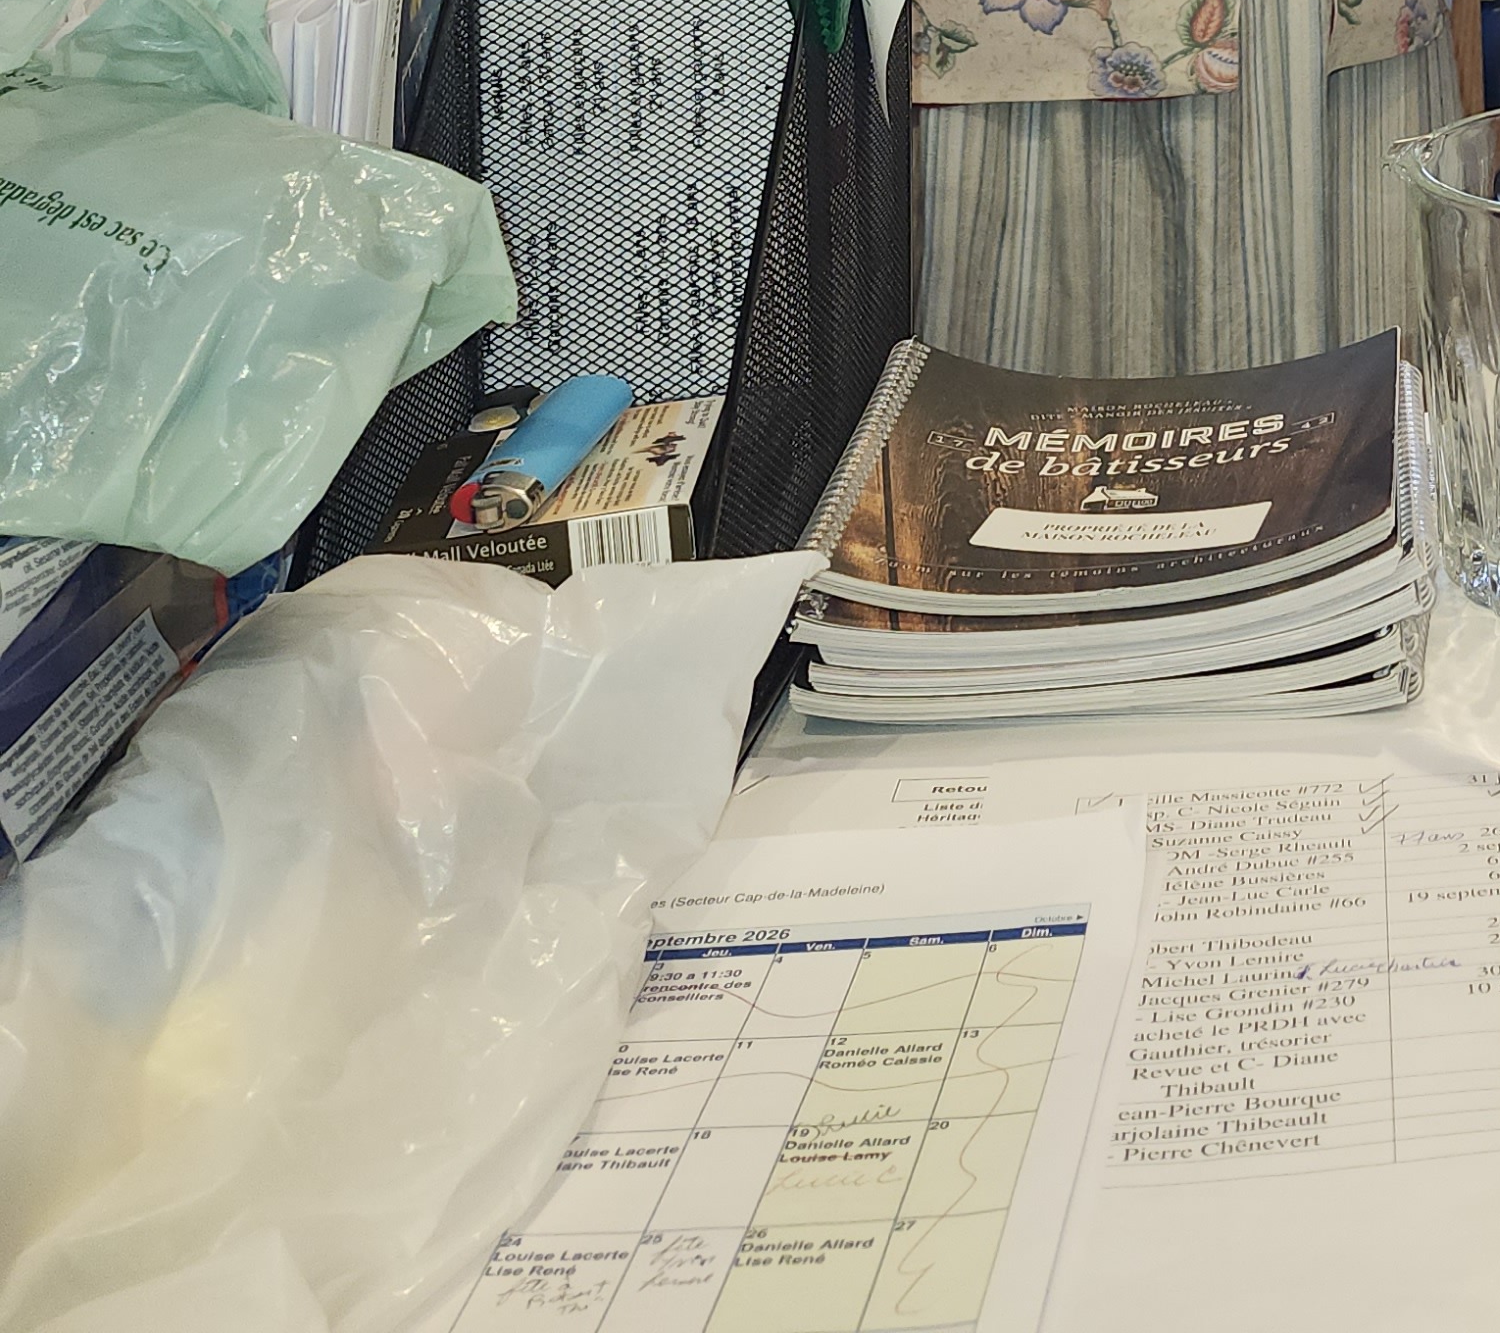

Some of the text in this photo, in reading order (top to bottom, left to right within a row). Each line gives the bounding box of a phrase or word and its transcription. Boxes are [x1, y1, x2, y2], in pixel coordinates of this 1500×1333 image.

[70, 207, 107, 234] est
[104, 218, 144, 251] sac
[140, 239, 174, 274] Ce
[984, 413, 1285, 453] MÉMOIRES
[966, 435, 1292, 477] de bâtisseurs
[1020, 531, 1096, 542] MAISON
[466, 534, 548, 559] Veloutée
[1191, 783, 1344, 802] Massicotte #772
[924, 803, 965, 812] Liste
[1208, 798, 1341, 815] Nicole Séguin
[1191, 813, 1331, 830] Diane Trudeau
[1151, 829, 1303, 848] Suzanne Caissy
[1278, 839, 1352, 853] Rheault
[1168, 862, 1228, 876] André
[1307, 852, 1355, 865] #255
[1231, 871, 1325, 886] Bussières
[671, 883, 886, 910] (Secteur Cap-de-la-Madeleine)
[1178, 884, 1330, 906] Jean-Luc Carle
[1407, 891, 1430, 903] 19
[1206, 897, 1366, 919] Robindaine #66
[702, 927, 1054, 959] Jeu. Ven. Sam. Dim.
[743, 928, 791, 943] 2026
[1202, 933, 1313, 953] Thibodeau
[1167, 950, 1304, 970] Yvon Lemire
[650, 968, 743, 983] 9:30 11:30
[1141, 971, 1215, 989] Michel
[643, 979, 752, 994] rencontre des
[1138, 977, 1370, 1009] Jacques Grenier #279
[1468, 982, 1491, 994] 10
[638, 992, 724, 1005] conseillers
[1152, 995, 1355, 1024] Lise Grondin #230
[1133, 1012, 1367, 1043] acheté le PRDH avec
[736, 1029, 980, 1050] 11 12 13
[1129, 1032, 1333, 1062] Gauthier, trésorier
[613, 1052, 725, 1065] ouise Lacerte
[823, 1042, 944, 1058] Danielle Allard
[636, 1065, 679, 1076] René
[819, 1053, 943, 1070] Roméo Caissie
[1131, 1050, 1339, 1081] Revue et Diane
[1160, 1078, 1256, 1098] Thibault
[1244, 1090, 1342, 1113] Bourque
[693, 1120, 950, 1140] 18 19 20
[1216, 1113, 1328, 1135] Thibeault
[615, 1145, 680, 1157] Lacerte
[784, 1136, 912, 1151] Danielle Allard
[1122, 1134, 1321, 1163] Pierre Chênevert
[600, 1158, 671, 1170] Thibault
[500, 1220, 916, 1248] 24 25 26 27
[740, 1237, 875, 1254] Danielle Allard
[493, 1249, 630, 1262] Louise Lacerte
[734, 1254, 826, 1268] Lise René
[485, 1264, 577, 1277] Lise René
